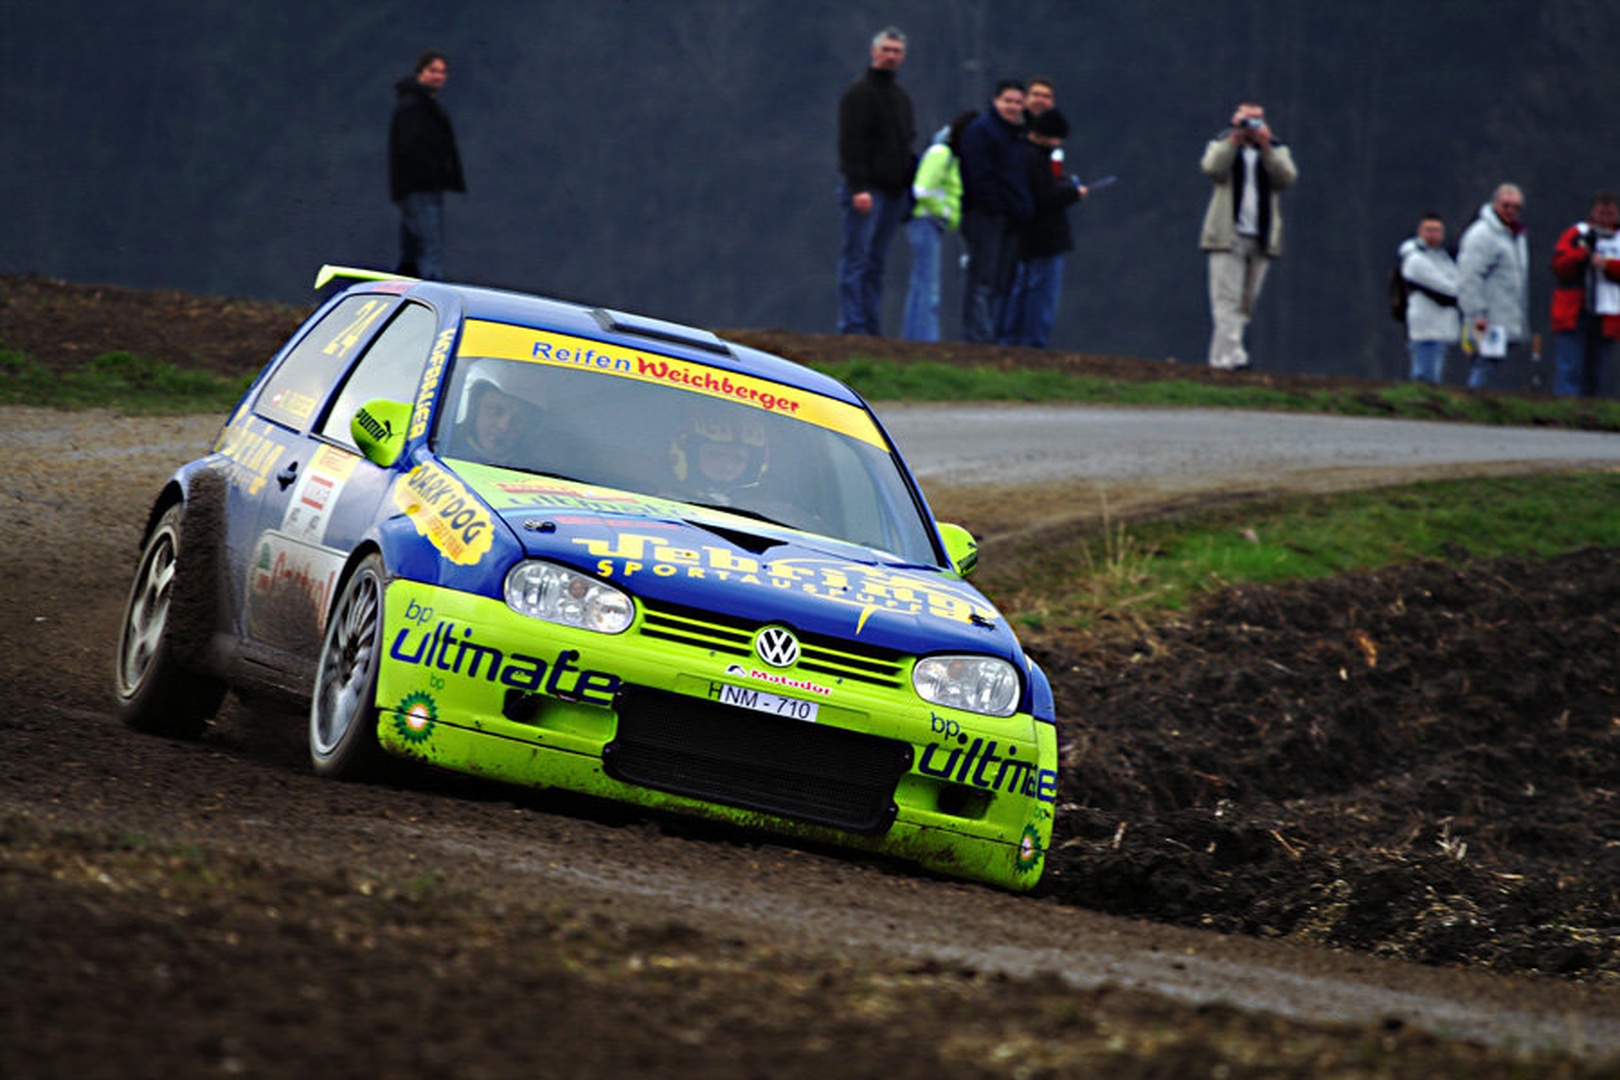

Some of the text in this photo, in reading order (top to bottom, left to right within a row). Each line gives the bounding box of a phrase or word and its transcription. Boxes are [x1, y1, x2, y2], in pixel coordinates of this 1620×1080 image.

[532, 341, 801, 412] Reifen Weichberger
[355, 407, 387, 442] PUMA
[404, 598, 433, 624] bp
[389, 621, 622, 706] ultimate
[750, 669, 832, 697] Matador
[776, 696, 812, 720] 710
[930, 710, 961, 741] bp
